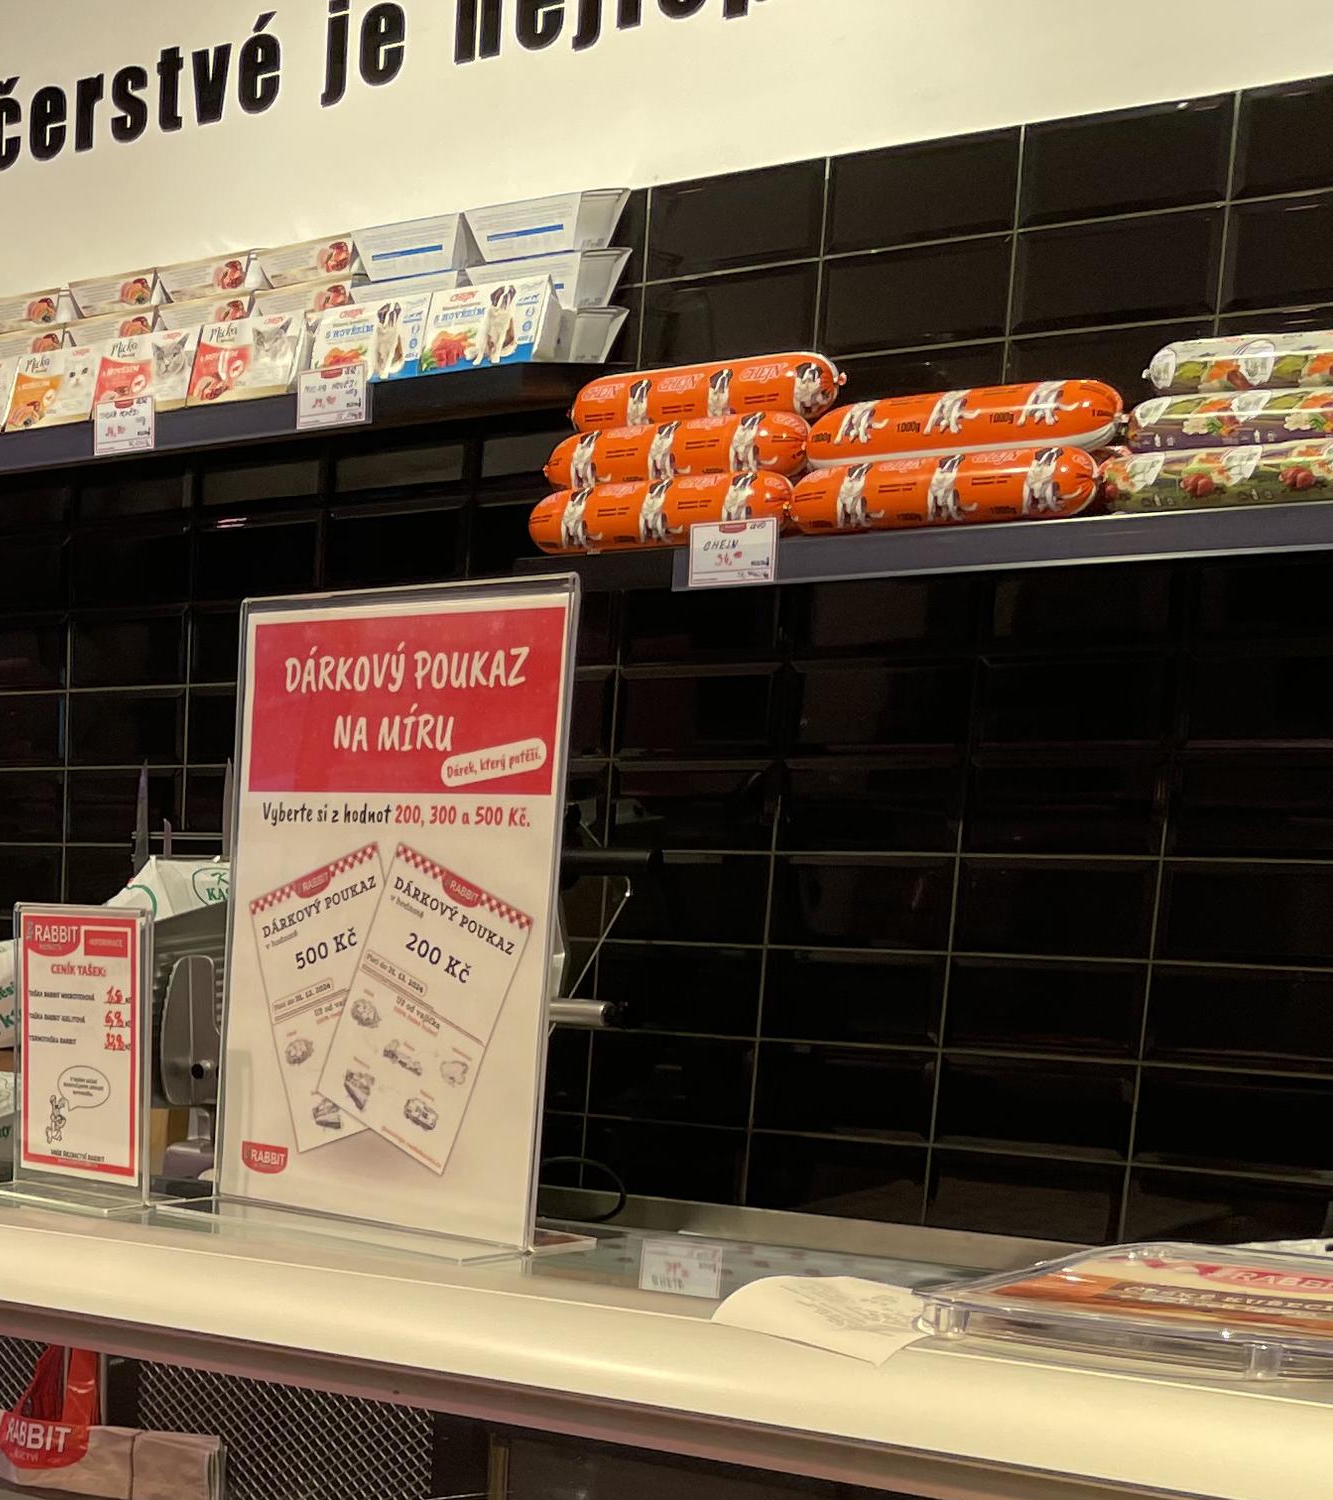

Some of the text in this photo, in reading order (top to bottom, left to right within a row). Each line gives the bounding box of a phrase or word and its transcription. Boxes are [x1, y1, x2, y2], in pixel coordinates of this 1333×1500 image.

[321, 0, 406, 107] je
[285, 641, 530, 694] DÁRKOVÝ POUKAZ
[333, 703, 455, 752] NA MÍRU
[446, 754, 506, 779] Dárek, který
[263, 802, 531, 827] Vyberte si z hodnot 200, 300 a 500 Kč.
[301, 873, 330, 893] RABBIT
[449, 878, 481, 905] RABBIT
[262, 875, 377, 938] DÁRKOVÝ POUKAZ
[393, 876, 515, 956] DÁRKOVÝ POUKAZ
[34, 924, 78, 943] RABBIT
[295, 926, 358, 969] 500 Kč
[51, 962, 106, 977] CENÍK TAŠEK:
[404, 933, 471, 984] 200 Kč
[250, 1149, 287, 1167] RABBIT
